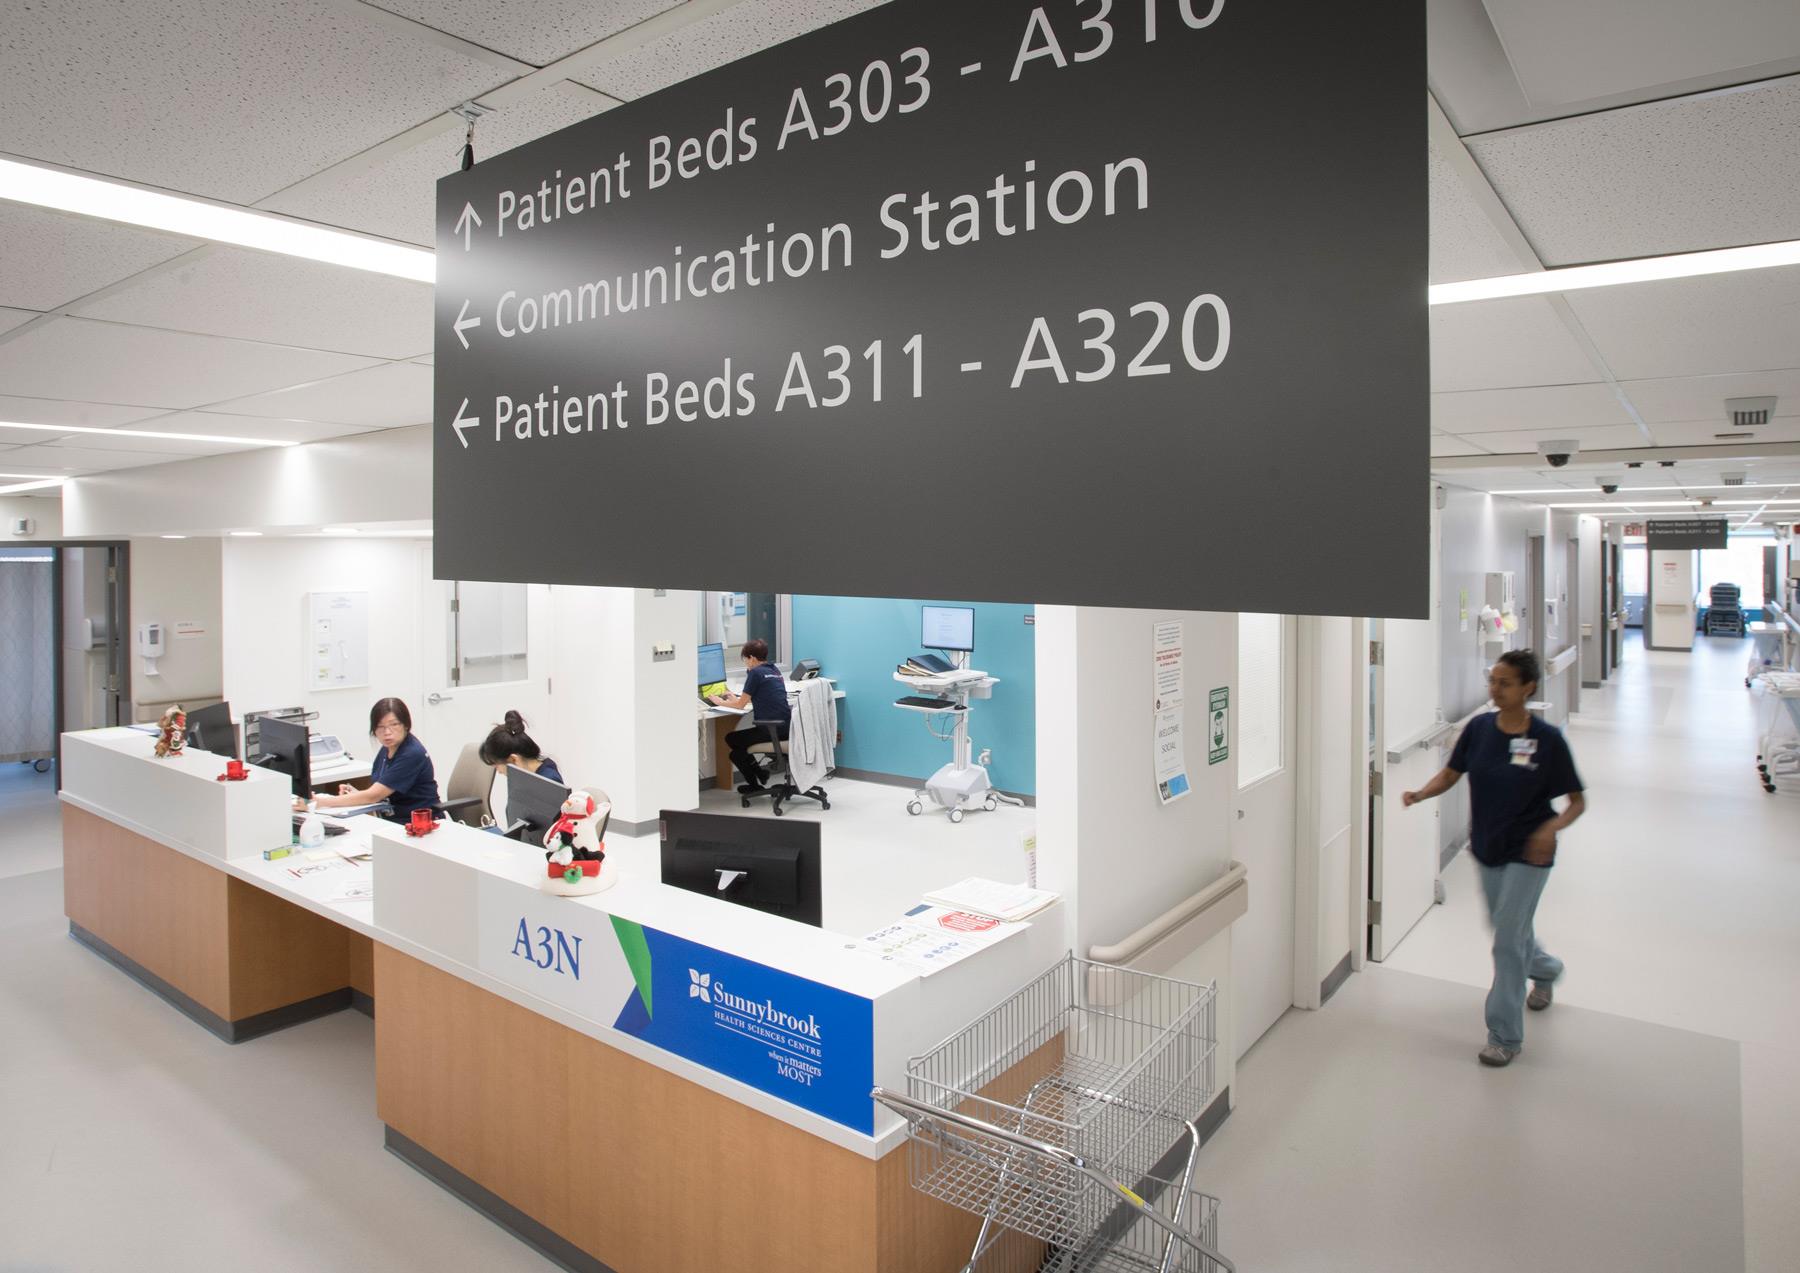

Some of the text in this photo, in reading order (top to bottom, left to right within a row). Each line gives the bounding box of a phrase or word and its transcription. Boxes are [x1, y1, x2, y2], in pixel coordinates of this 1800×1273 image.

[498, 151, 631, 237] Patient
[648, 106, 758, 190] Beds
[776, 46, 931, 151] A303
[960, 61, 982, 76] -
[496, 157, 1149, 338] Communication Station
[495, 293, 1231, 442] Patient Beds A311 - A320
[511, 916, 583, 981] A3N
[713, 981, 822, 1040] Sunnybrook
[714, 1010, 822, 1058] HEALTH SCIENCES CENTRE
[768, 1050, 784, 1063] when
[789, 1057, 822, 1077] matters
[777, 1062, 814, 1087] MOST
